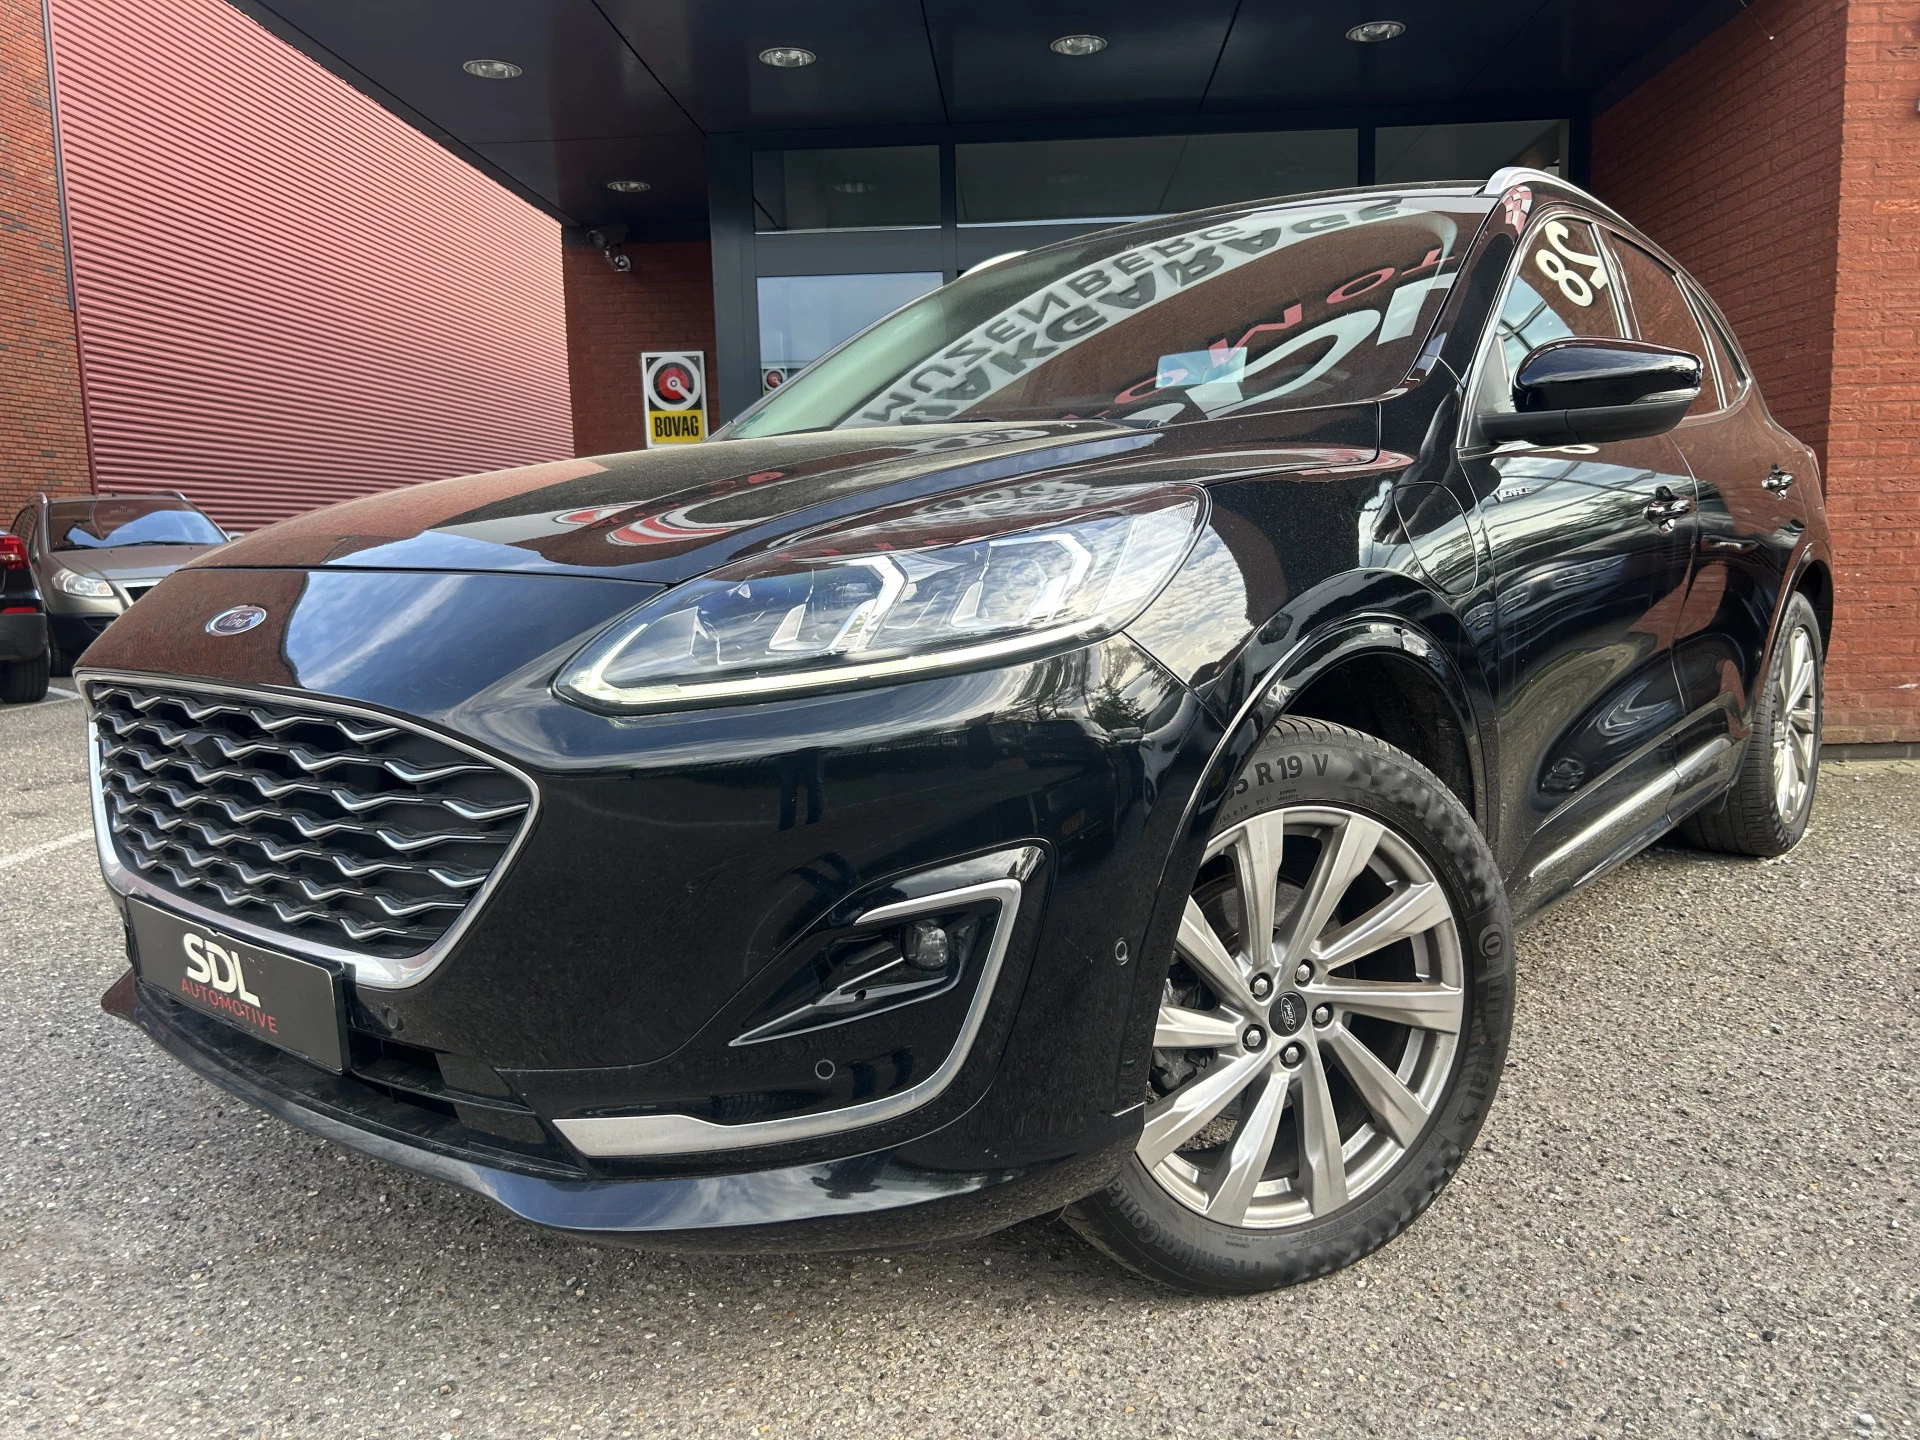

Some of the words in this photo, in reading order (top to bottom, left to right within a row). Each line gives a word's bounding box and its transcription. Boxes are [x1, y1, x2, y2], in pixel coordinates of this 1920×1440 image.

[654, 415, 699, 437] BOVAG
[1276, 755, 1303, 780] 19
[1311, 753, 1329, 776] V
[183, 932, 261, 1007] SDL
[181, 977, 278, 1034] AUTOMOTIVE
[1283, 1002, 1295, 1026] Ford
